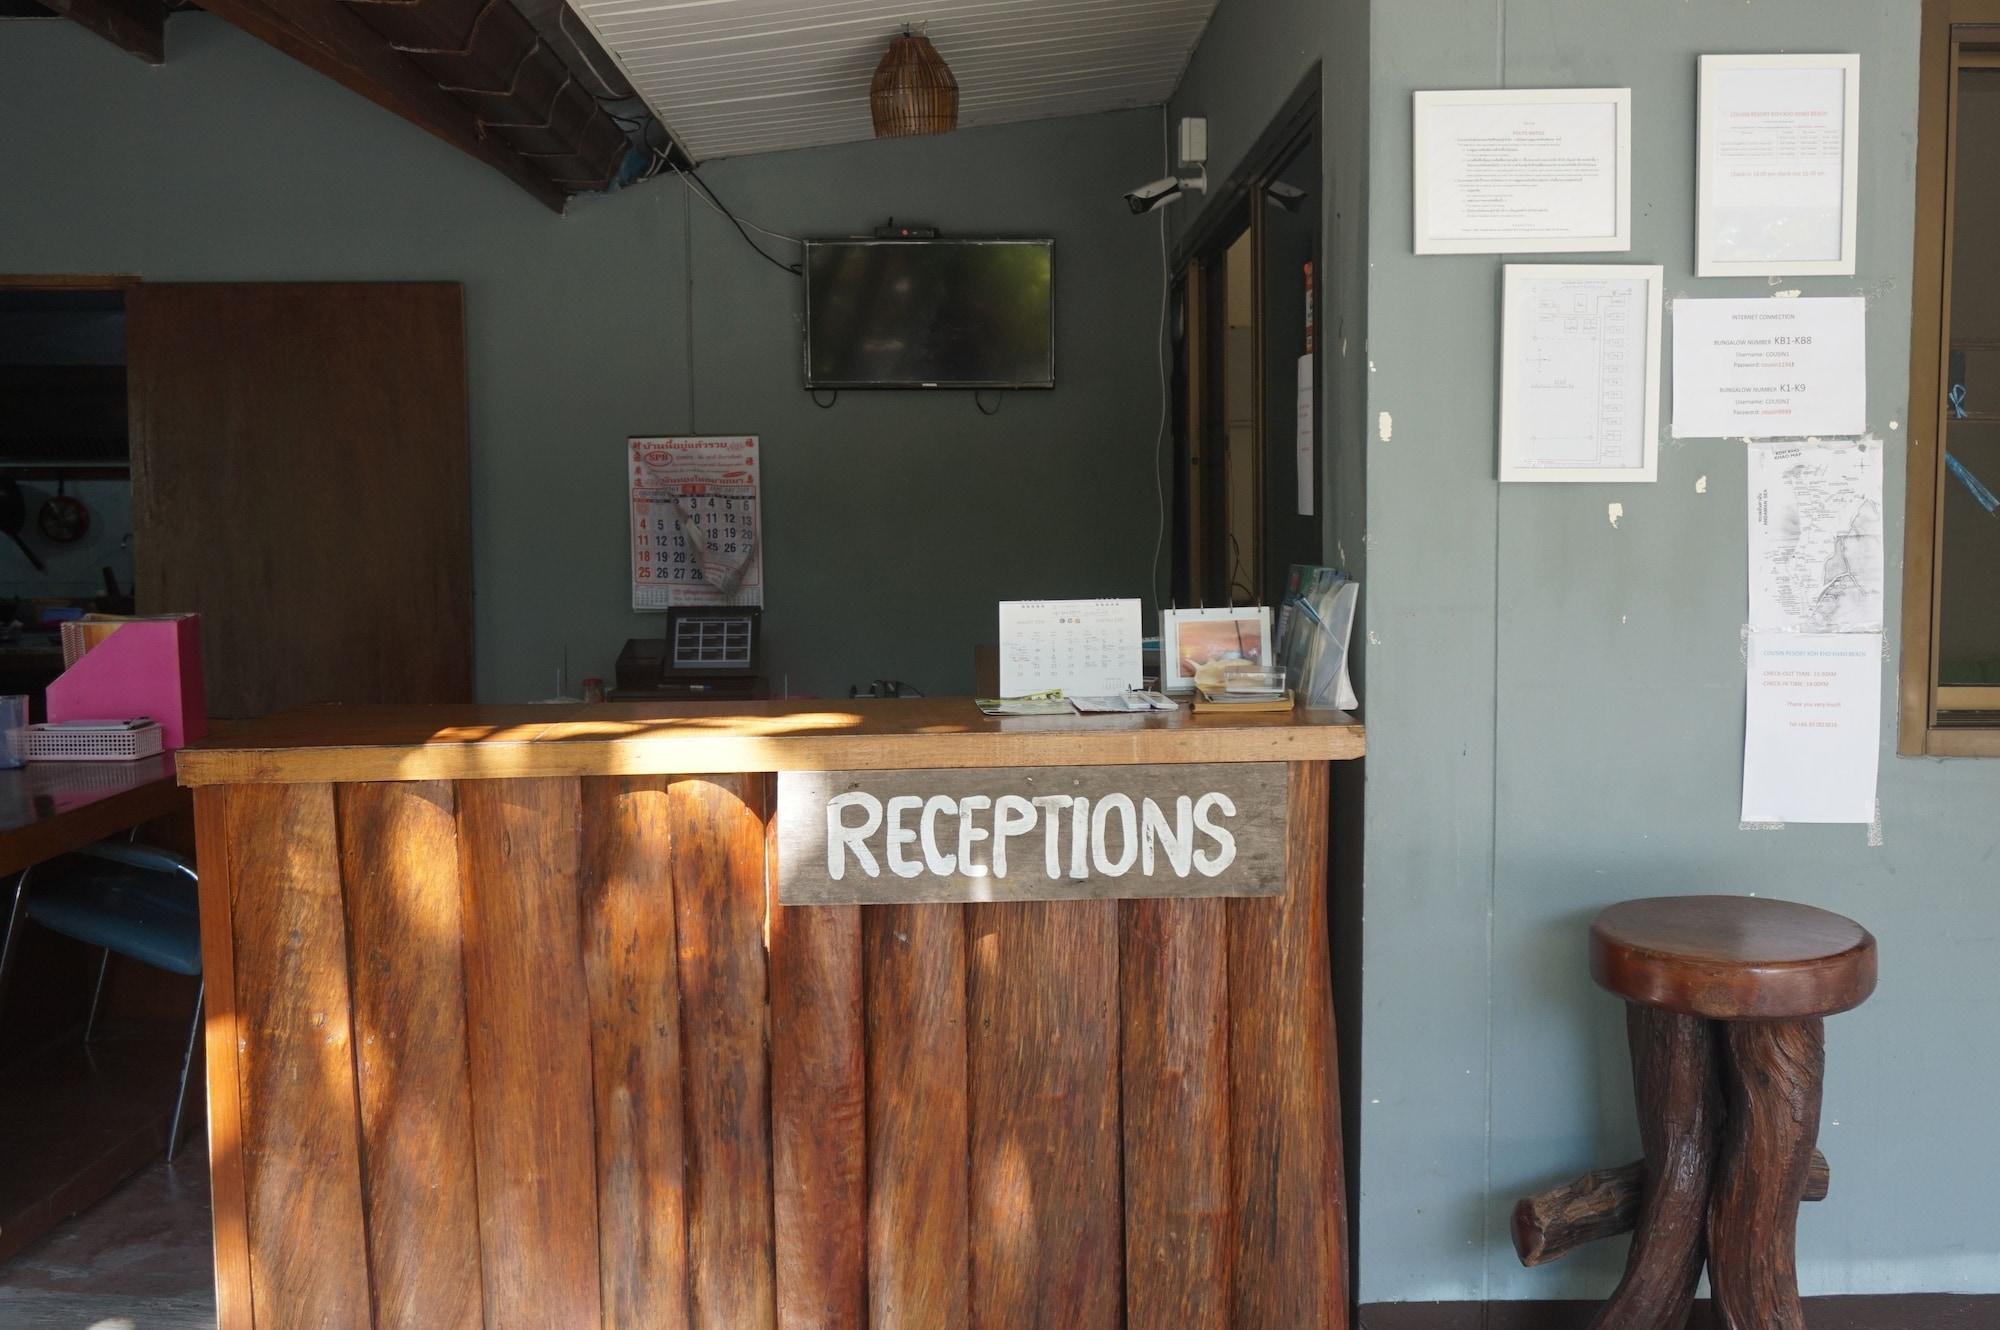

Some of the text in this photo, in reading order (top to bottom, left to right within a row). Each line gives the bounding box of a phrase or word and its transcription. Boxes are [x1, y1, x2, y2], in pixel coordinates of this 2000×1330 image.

[1774, 336, 1812, 345] KB1-KB8
[1780, 384, 1806, 392] K1-K9
[691, 499, 697, 509] 3
[708, 498, 714, 507] 4
[726, 500, 732, 509] 5
[744, 500, 750, 510] 6
[640, 519, 646, 528] 4
[657, 520, 664, 530] 5
[707, 513, 717, 523] 11
[724, 513, 735, 523] 12
[742, 516, 752, 526] 13
[707, 529, 718, 539] 18
[724, 528, 736, 538] 19
[638, 536, 684, 546] 11 12 13
[707, 543, 718, 551] 25
[724, 543, 736, 552] 26
[639, 551, 650, 561] 18
[656, 552, 668, 562] 19
[674, 552, 685, 562] 20
[639, 568, 703, 579] 25 26 27 28
[826, 791, 1238, 880] RECEPTIONS
